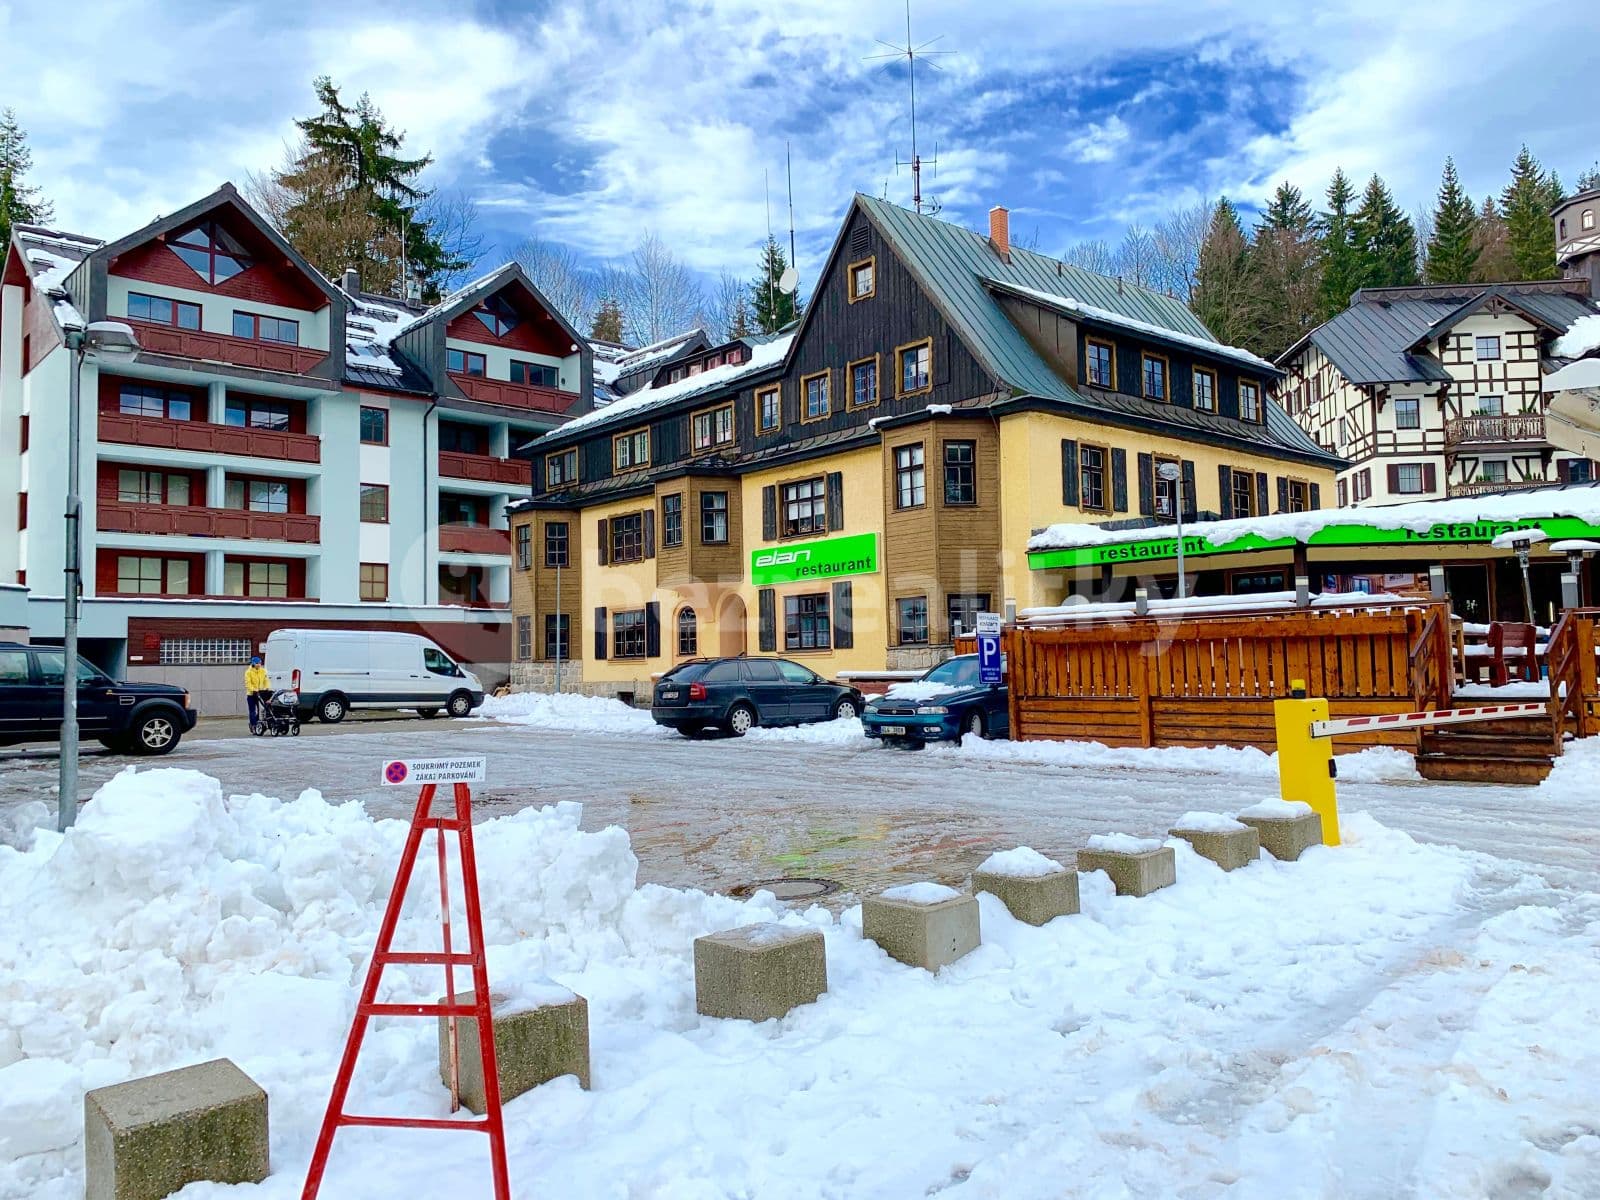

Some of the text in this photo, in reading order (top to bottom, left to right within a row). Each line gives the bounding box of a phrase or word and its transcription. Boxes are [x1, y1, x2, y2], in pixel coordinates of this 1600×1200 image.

[756, 549, 811, 567] elan
[1100, 538, 1204, 560] restaurant
[796, 556, 871, 576] restaurant
[983, 639, 997, 666] P
[450, 760, 481, 769] POZEMEK
